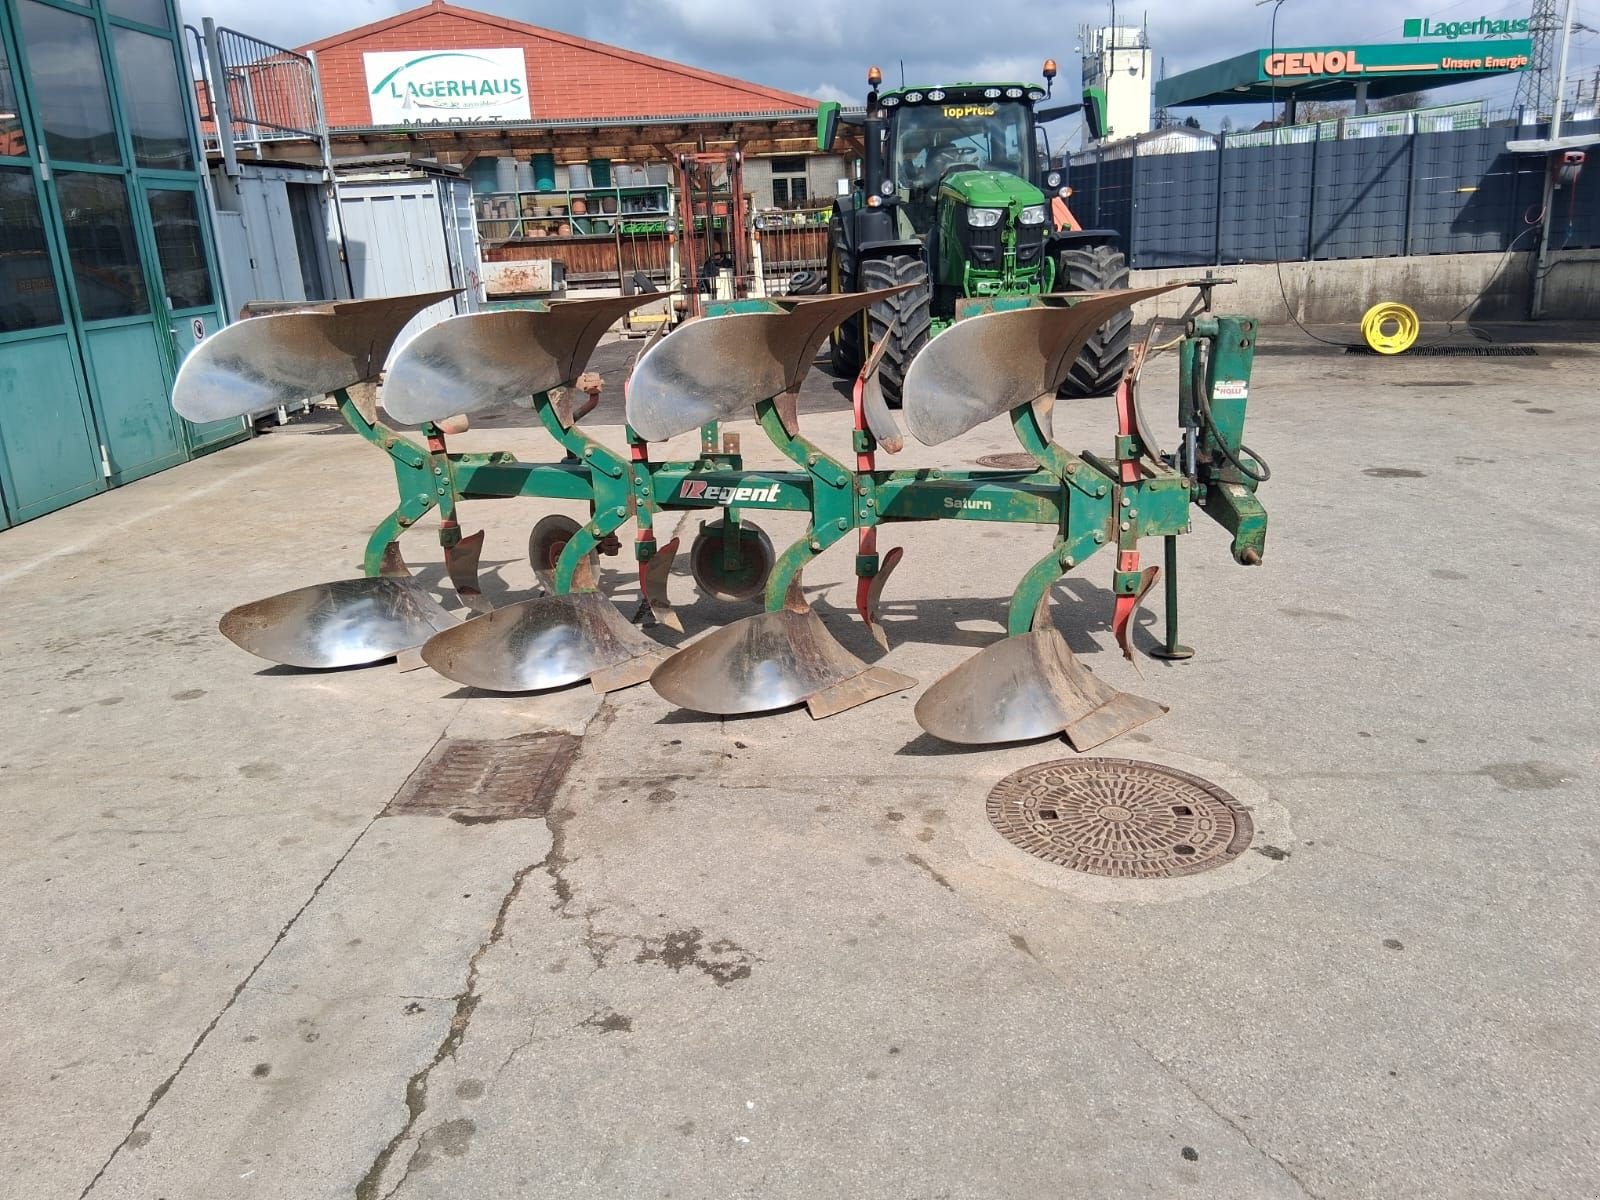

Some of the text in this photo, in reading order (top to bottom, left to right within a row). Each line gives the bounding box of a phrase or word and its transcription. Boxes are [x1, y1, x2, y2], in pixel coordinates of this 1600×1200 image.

[1423, 16, 1529, 39] Lagerhaus
[1264, 50, 1364, 76] GENOL
[1442, 55, 1528, 70] Unsere Energie
[390, 78, 522, 99] LAGERHAUS
[943, 106, 964, 119] Top
[680, 480, 780, 504] Regent
[943, 497, 992, 510] Saturn
